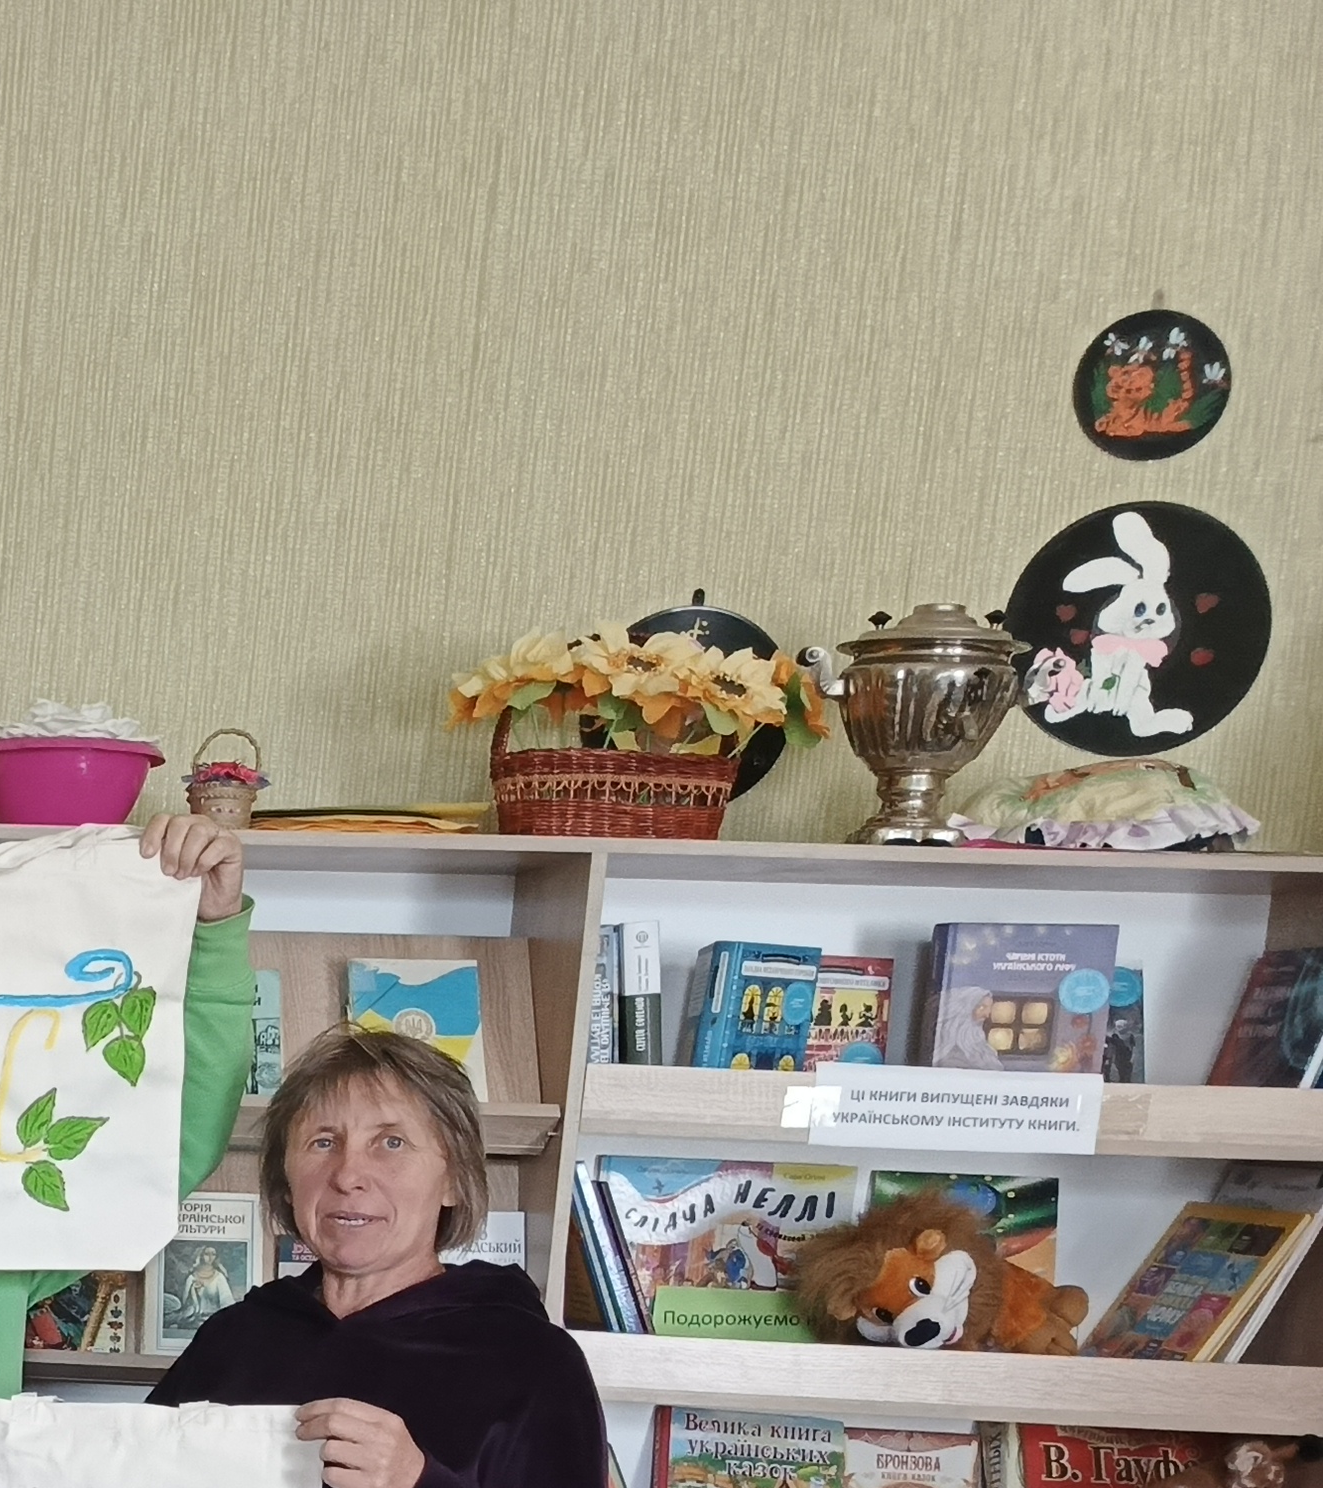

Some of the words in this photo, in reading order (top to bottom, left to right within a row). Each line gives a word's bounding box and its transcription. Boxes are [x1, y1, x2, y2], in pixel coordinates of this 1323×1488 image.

[850, 1089, 865, 1103] ЦІ
[869, 1090, 917, 1103] КНИГИ
[920, 1092, 998, 1108] ВИПУЩЕНІ
[1003, 1094, 1070, 1109] ЗАВДЯКИ
[832, 1110, 944, 1127] УКРАЇНСЬКОМУ
[947, 1115, 1024, 1131] ІНСТИТУТУ
[1027, 1120, 1081, 1133] КНИГИ.
[179, 1203, 212, 1213] ТОРІЯ
[624, 1193, 716, 1234] СЛІДЧА
[733, 1179, 837, 1223] НЕЛЛІ
[178, 1212, 246, 1225] РАЇНСЬКОЇ
[663, 1310, 800, 1334] Подорожуємо
[684, 1412, 763, 1438] Велика
[770, 1423, 832, 1444] книга
[687, 1437, 831, 1466] українських
[876, 1453, 941, 1472] БРОНЗОВА
[1038, 1441, 1083, 1483] В.
[725, 1459, 798, 1480] казок
